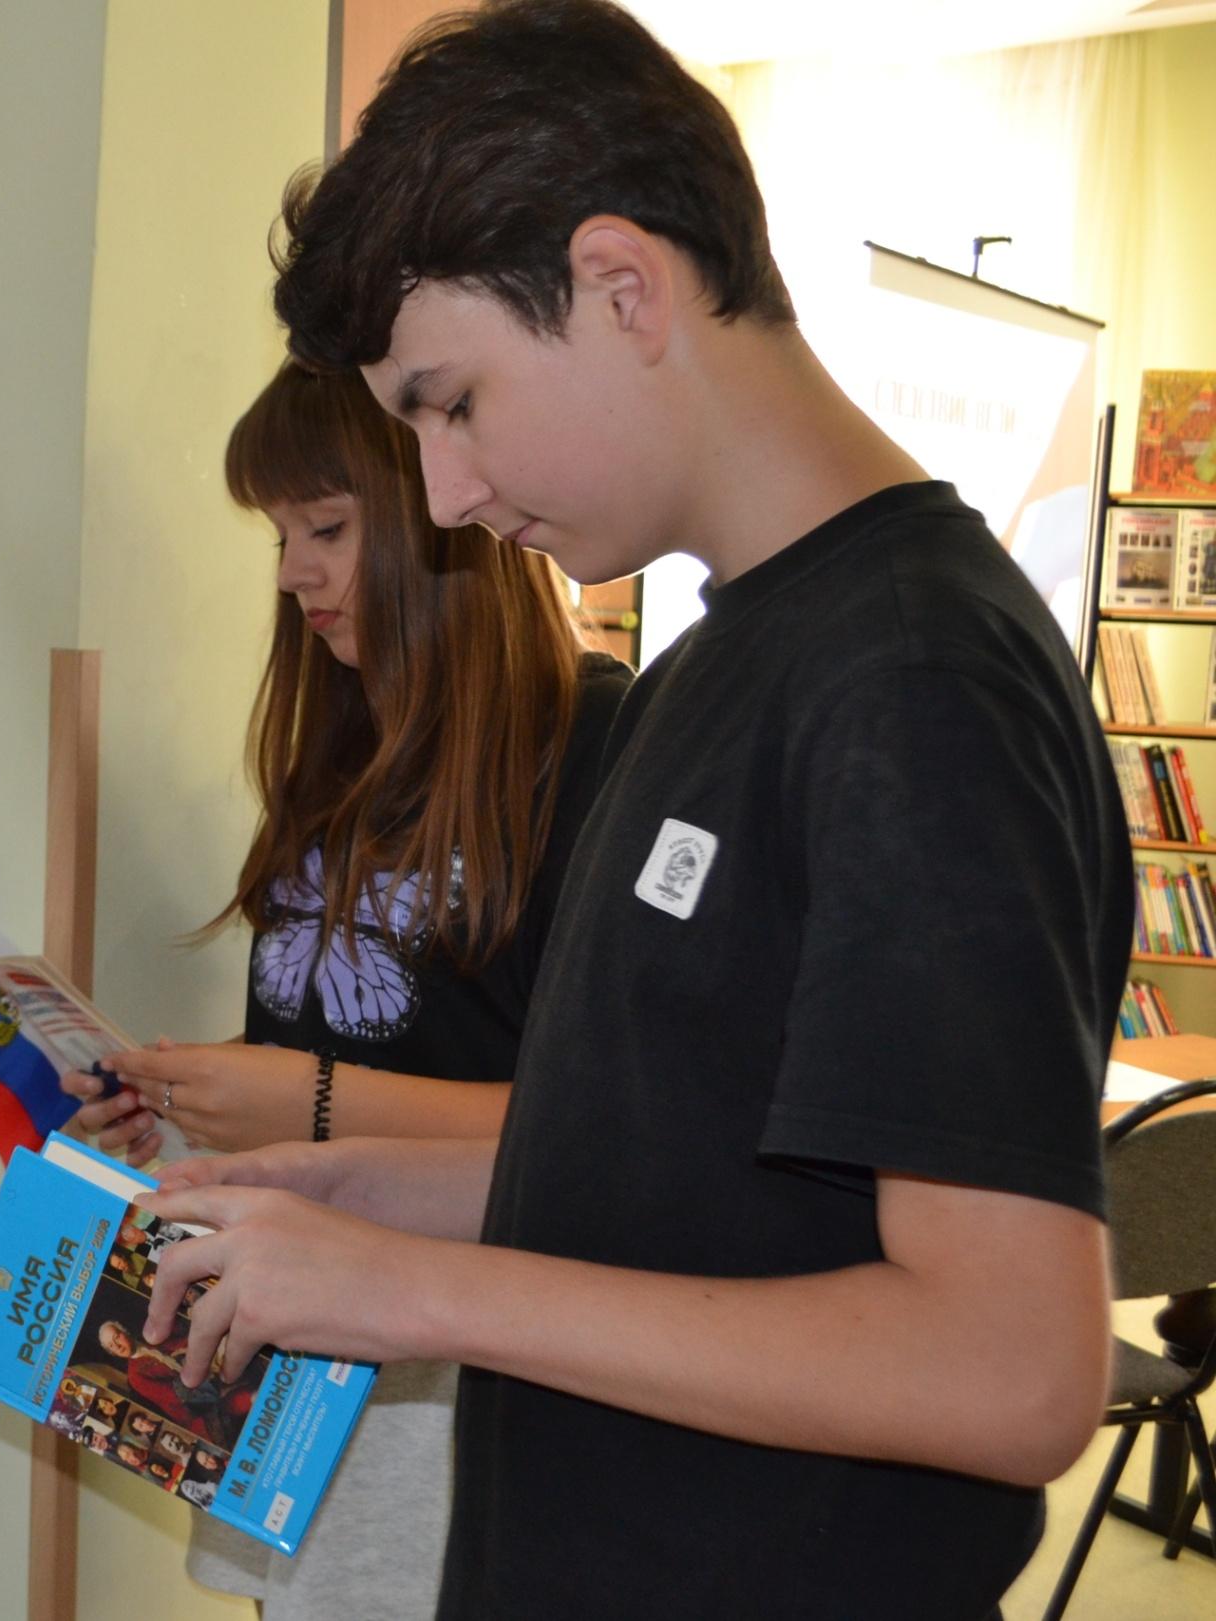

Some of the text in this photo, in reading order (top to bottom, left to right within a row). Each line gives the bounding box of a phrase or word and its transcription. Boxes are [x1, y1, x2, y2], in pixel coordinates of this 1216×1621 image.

[6, 1255, 46, 1327] ИМЯ
[16, 1236, 80, 1366] РОССИЯ
[32, 1301, 78, 1407] ИСТОРИЧЕСКИЙ
[70, 1251, 97, 1302] ВЫБОР
[227, 1479, 250, 1498] М.
[238, 1457, 259, 1475] В.
